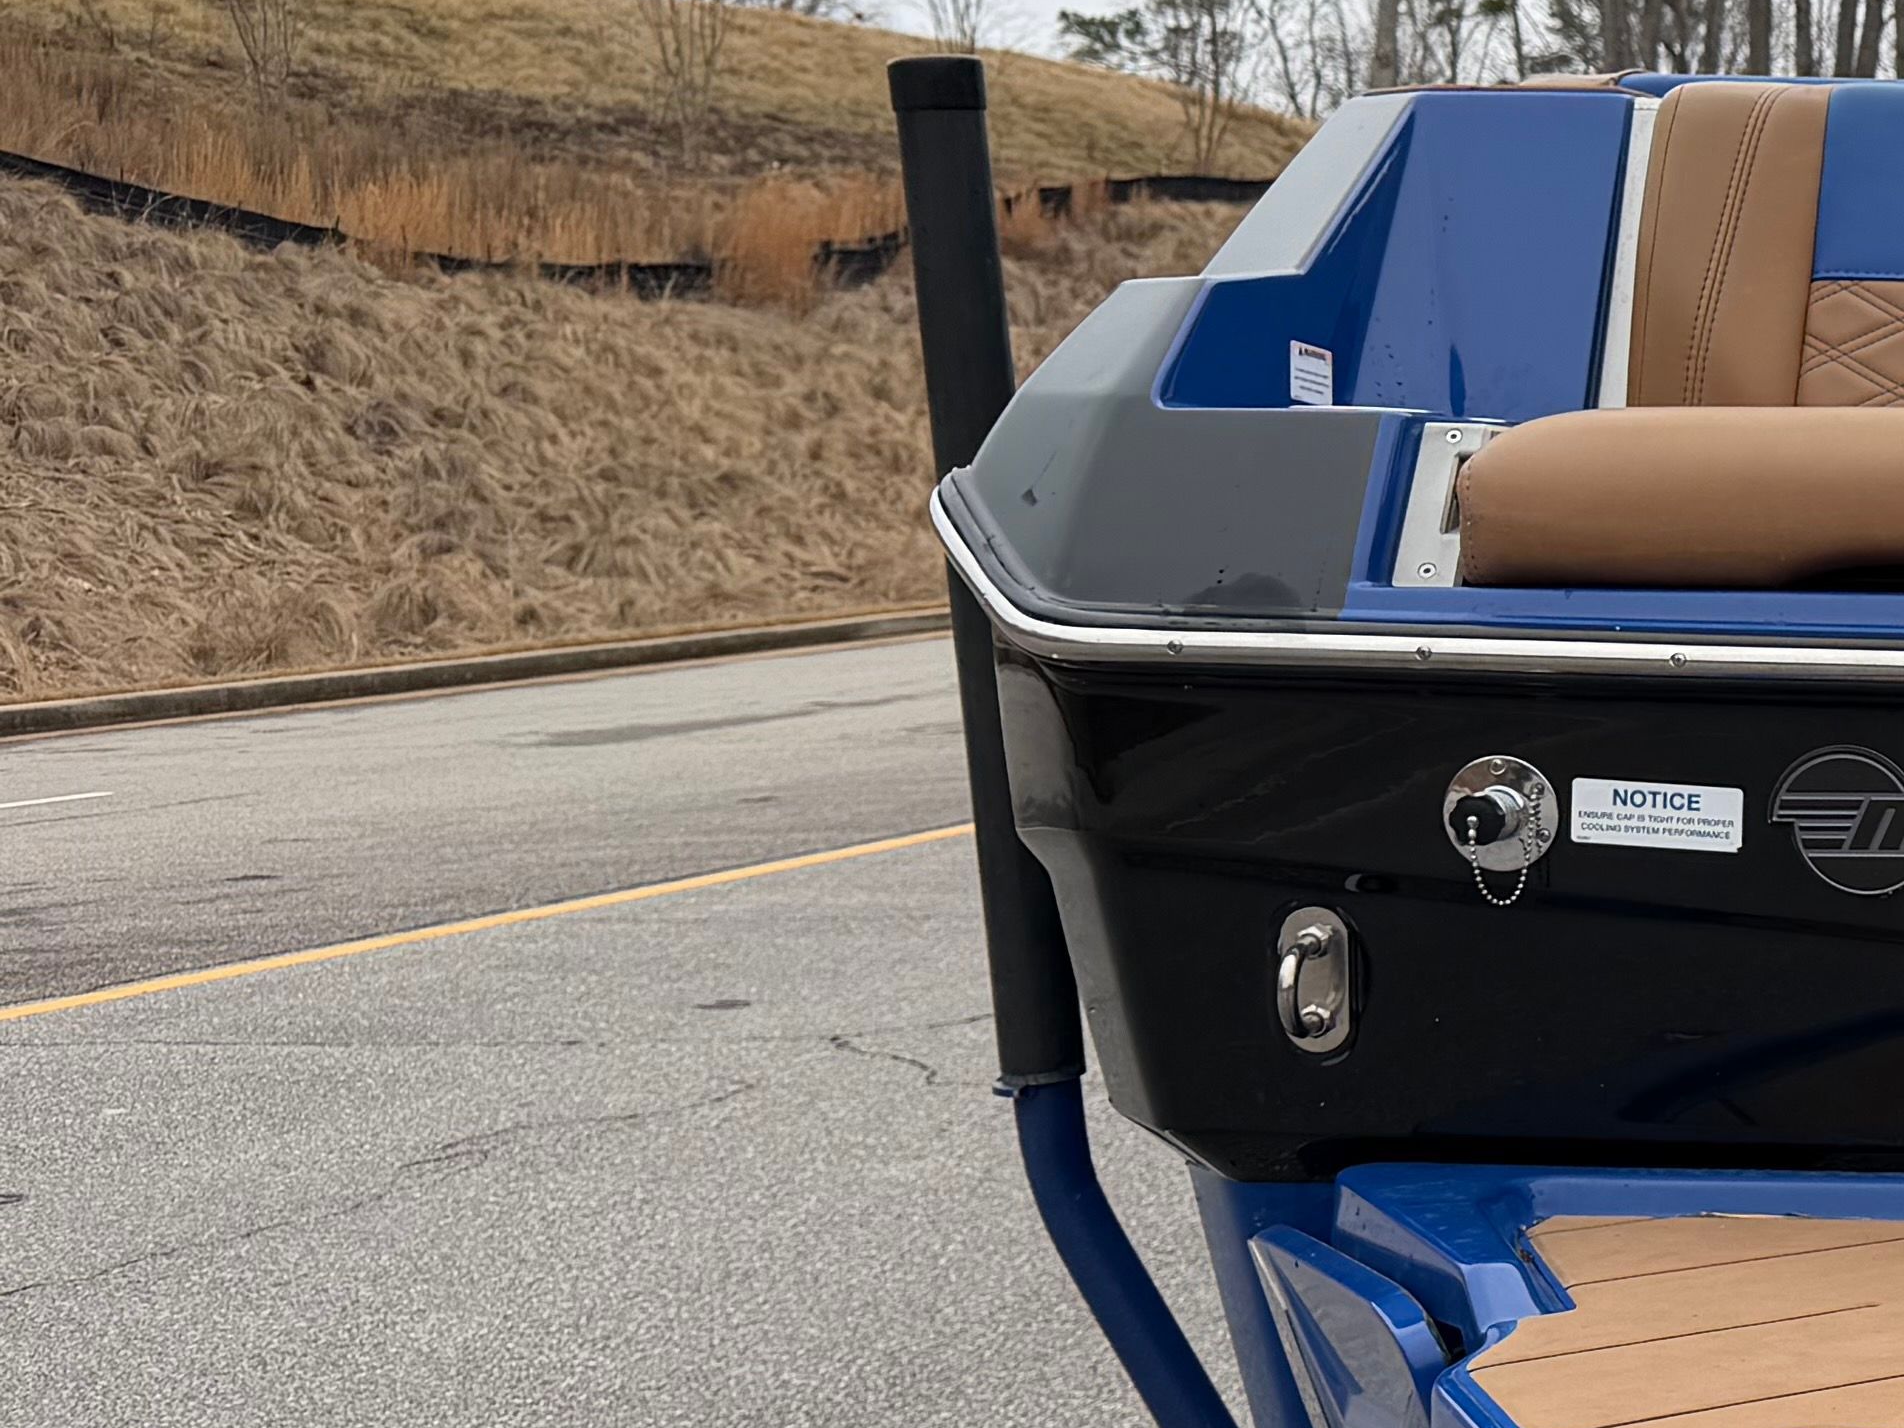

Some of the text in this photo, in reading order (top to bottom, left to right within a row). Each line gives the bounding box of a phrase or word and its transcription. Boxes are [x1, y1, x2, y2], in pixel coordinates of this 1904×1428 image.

[1612, 788, 1702, 812] NOTICE
[1578, 810, 1735, 829] ENSURE CAP IS TIGHT FOR PROPER
[1581, 822, 1731, 840] COOLING SYSTEM PERFORMANCE
